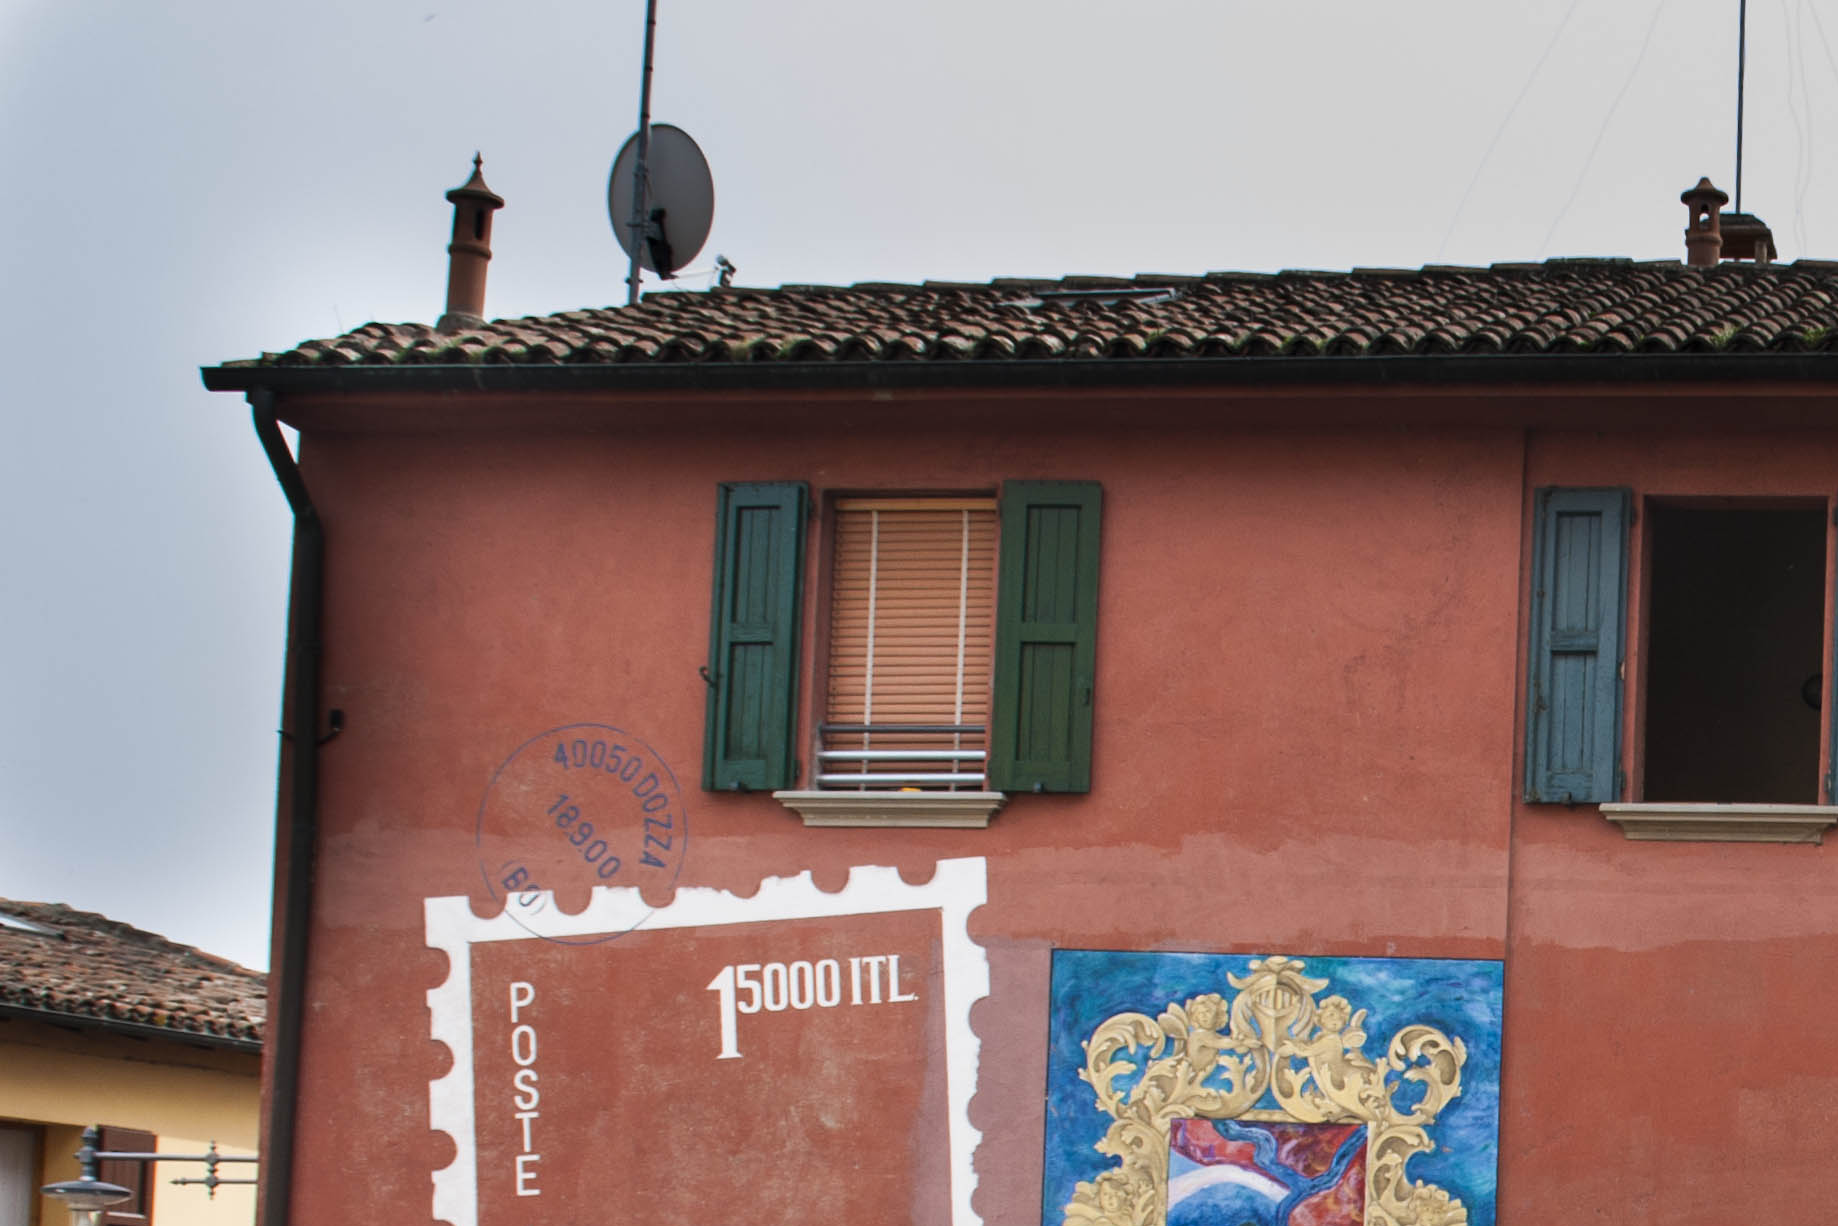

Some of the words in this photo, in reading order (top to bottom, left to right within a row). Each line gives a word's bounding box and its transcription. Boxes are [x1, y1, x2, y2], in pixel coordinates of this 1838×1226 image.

[552, 738, 642, 783] 40050
[632, 772, 673, 868] DOZZA
[706, 958, 841, 1060] 15000
[510, 981, 541, 1197] POSTE
